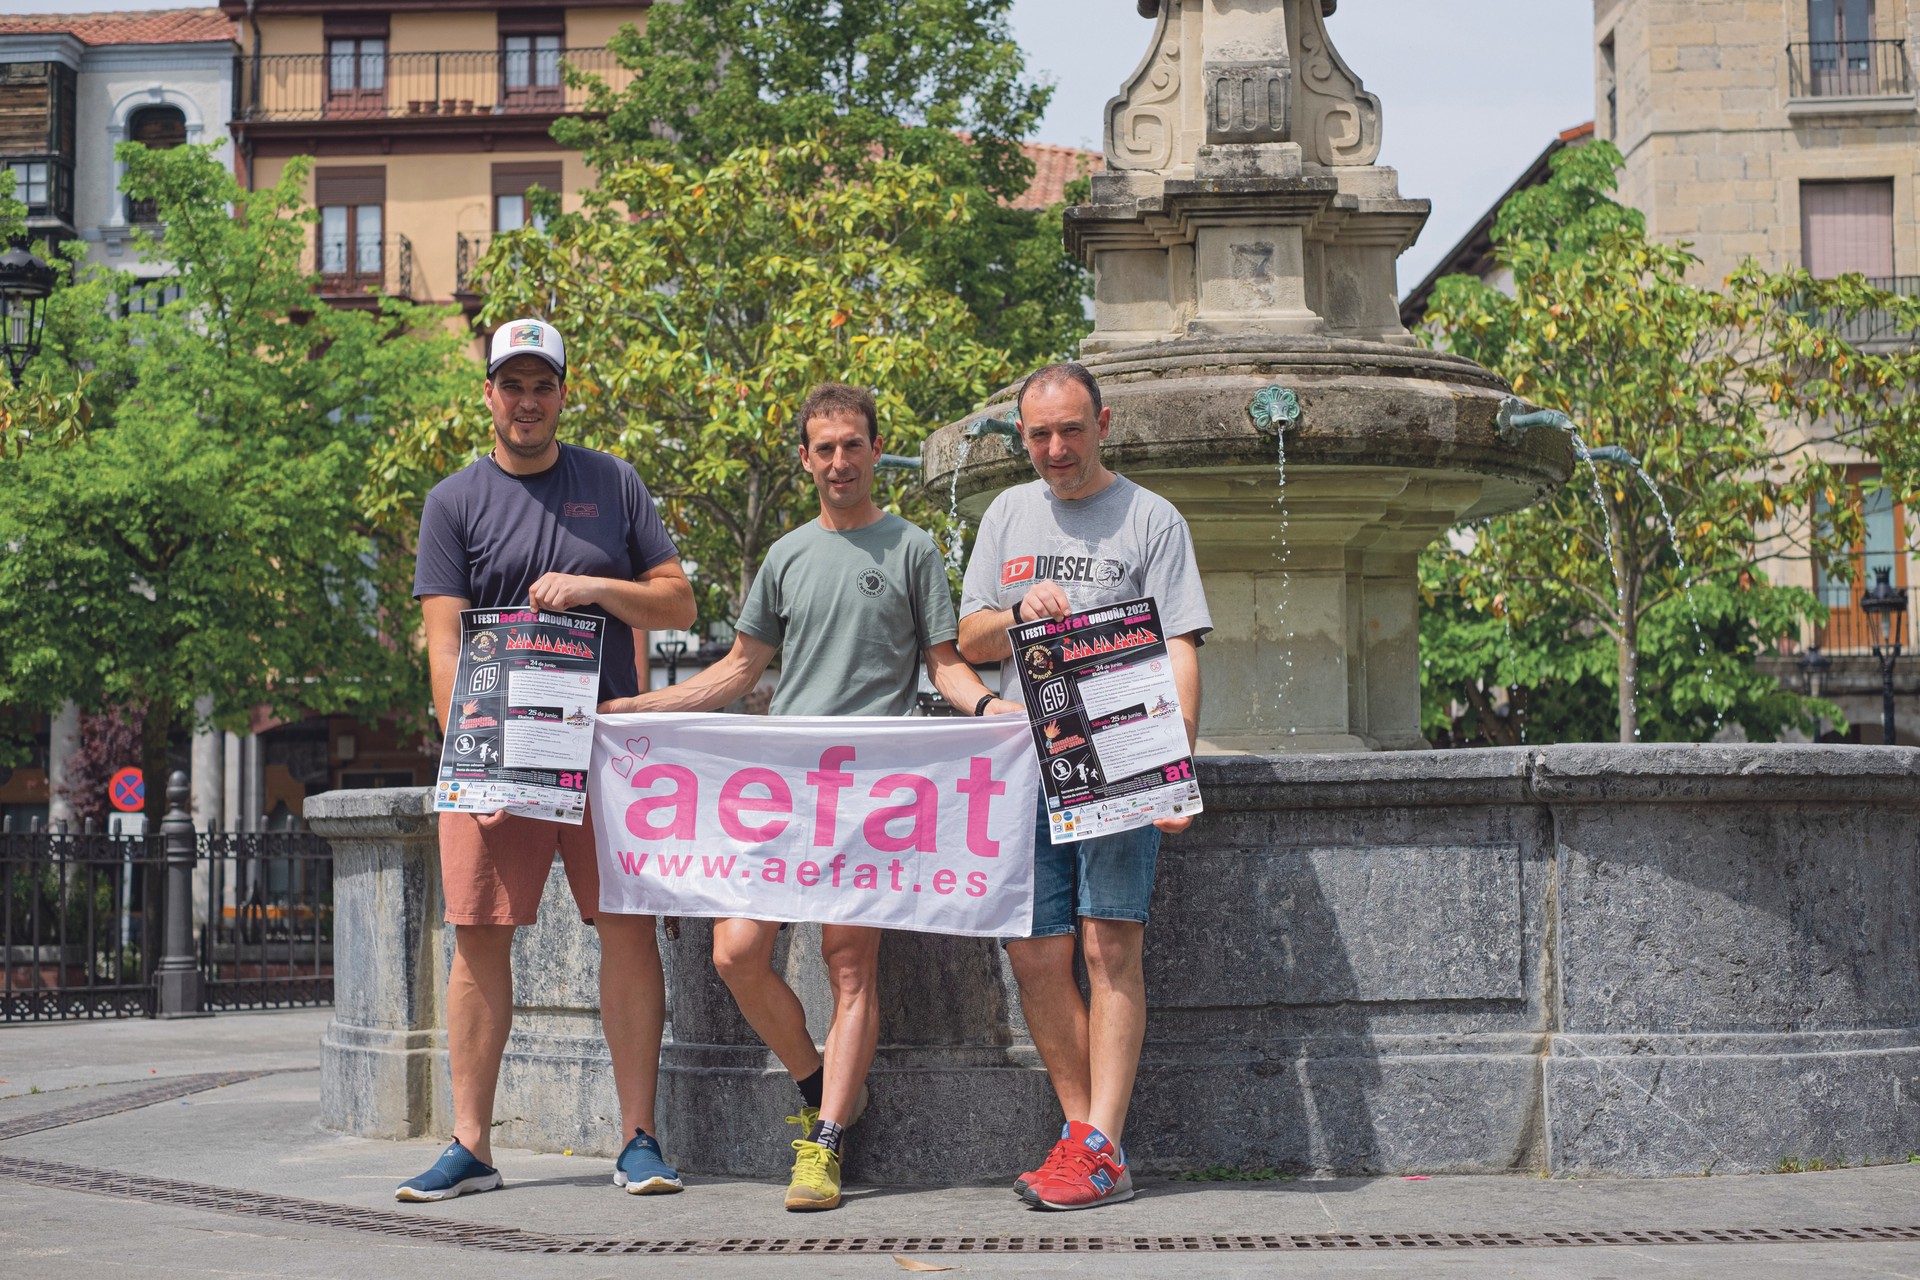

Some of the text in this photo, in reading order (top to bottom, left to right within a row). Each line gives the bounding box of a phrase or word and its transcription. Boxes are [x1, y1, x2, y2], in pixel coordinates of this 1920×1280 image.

[1034, 555, 1094, 582] DIESEL
[1126, 602, 1150, 617] 2022
[573, 619, 597, 632] 2022
[1110, 715, 1120, 723] 25
[624, 745, 1006, 858] aefat
[617, 851, 988, 897] www.aefat.es
[1088, 1168, 1115, 1195] N
